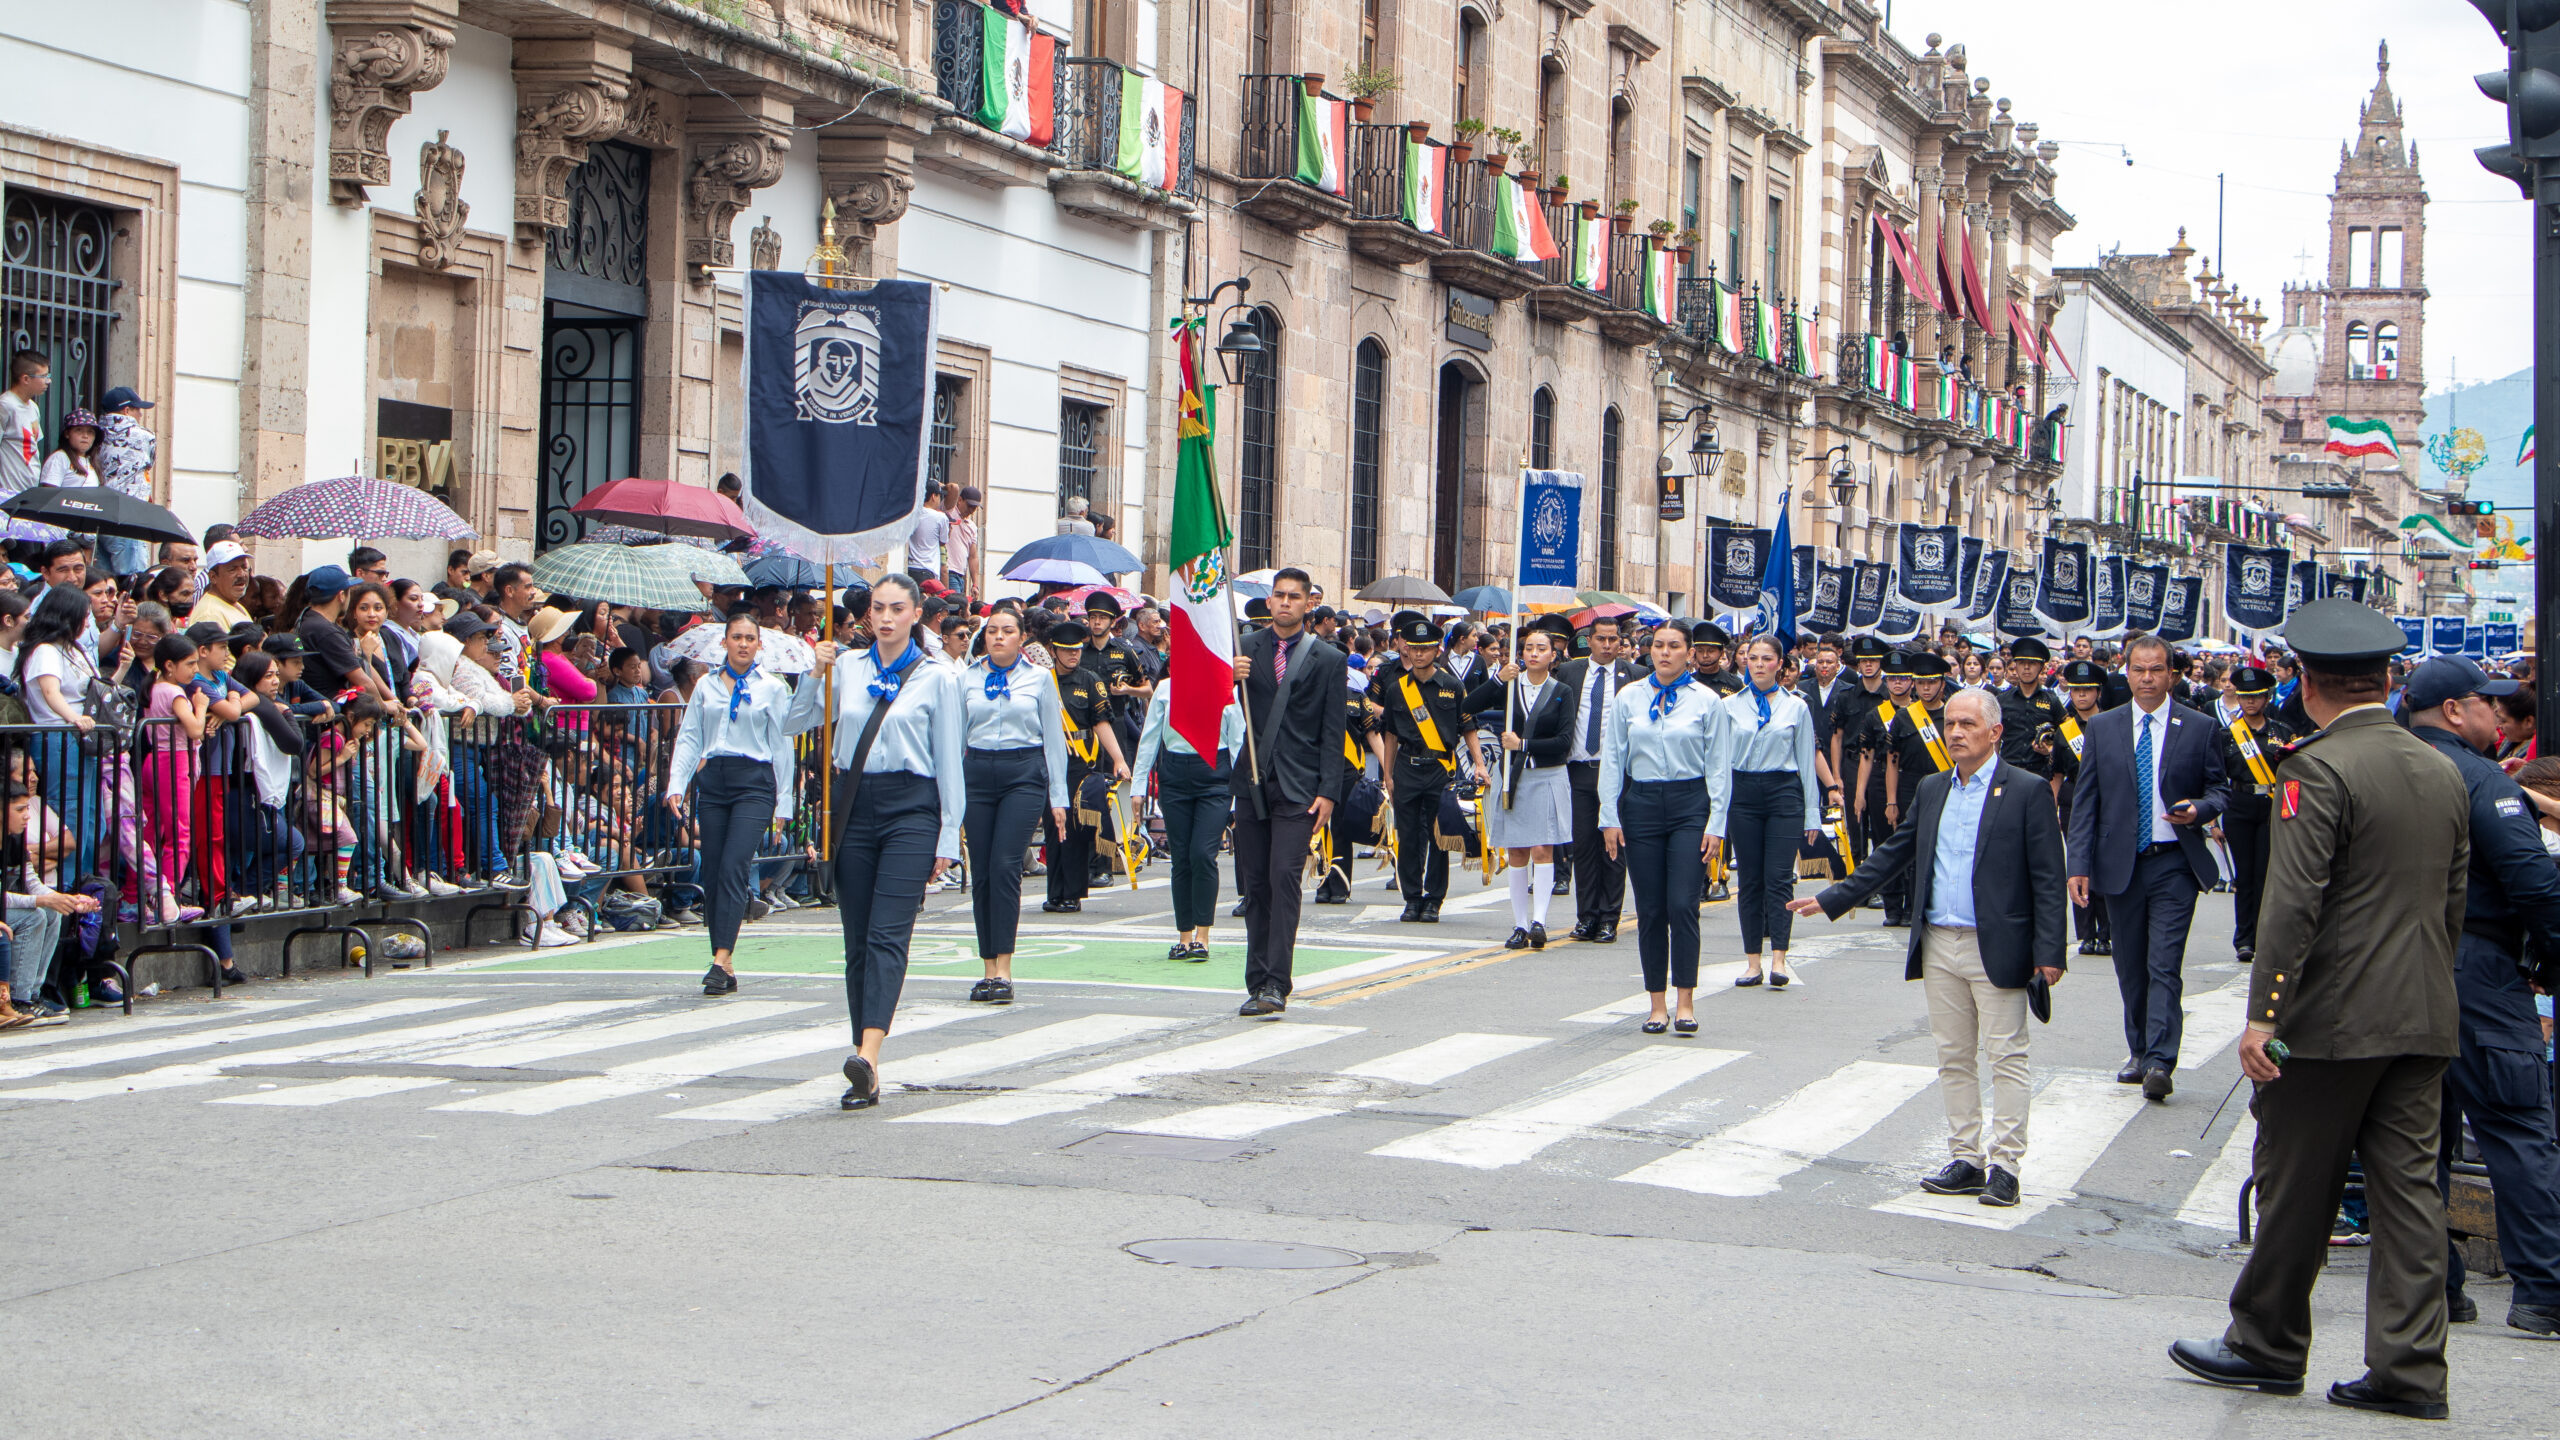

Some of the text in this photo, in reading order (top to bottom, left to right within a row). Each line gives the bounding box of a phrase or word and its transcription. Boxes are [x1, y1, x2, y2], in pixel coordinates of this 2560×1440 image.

[797, 300, 881, 326] UNIVERSIDAD VASCO DE QUIROGA
[376, 437, 461, 491] BBVA
[2240, 603, 2273, 612] NUTRICIÓN
[2495, 800, 2521, 808] GUARDIA
[2503, 806, 2520, 814] CIVIL
